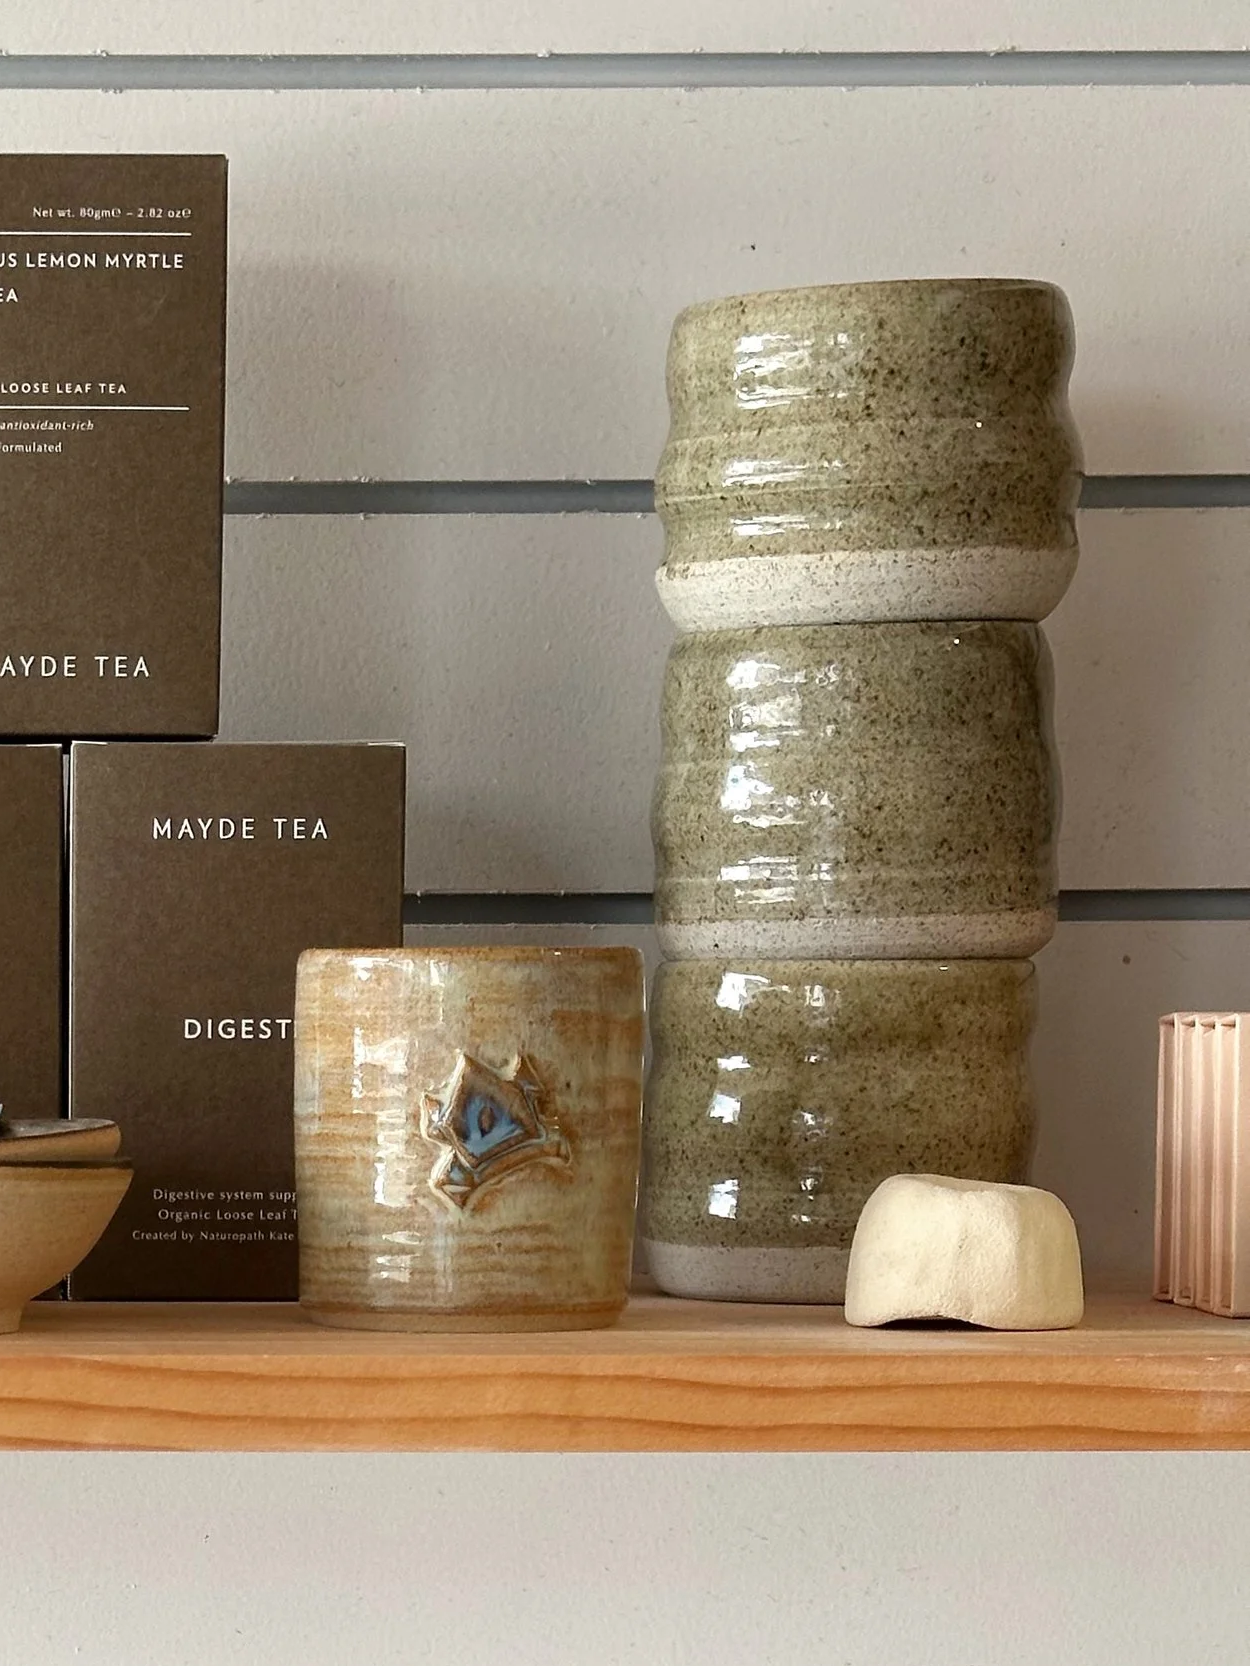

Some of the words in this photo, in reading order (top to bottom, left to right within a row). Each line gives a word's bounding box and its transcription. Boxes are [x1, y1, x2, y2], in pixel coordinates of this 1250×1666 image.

[33, 207, 53, 218] Net
[137, 208, 163, 219] 2.82
[26, 253, 97, 269] LEMON
[105, 253, 184, 269] MYRTLE
[1, 382, 50, 394] LOOSE
[56, 383, 92, 394] LEAF
[99, 383, 127, 394] TEA
[0, 420, 94, 431] antioxidant-rich
[95, 656, 150, 678] TEA
[152, 817, 254, 839] MAYDE
[273, 818, 328, 839] TEA
[184, 1018, 292, 1039] DIGEST
[153, 1189, 215, 1203] Digestive
[220, 1191, 263, 1203] system
[158, 1209, 211, 1223] Organic
[216, 1209, 254, 1220] Loose
[260, 1209, 287, 1220] Leaf
[132, 1230, 177, 1240] Created
[181, 1230, 194, 1243] by
[200, 1230, 264, 1243] Naturopath
[269, 1230, 294, 1240] Kate
